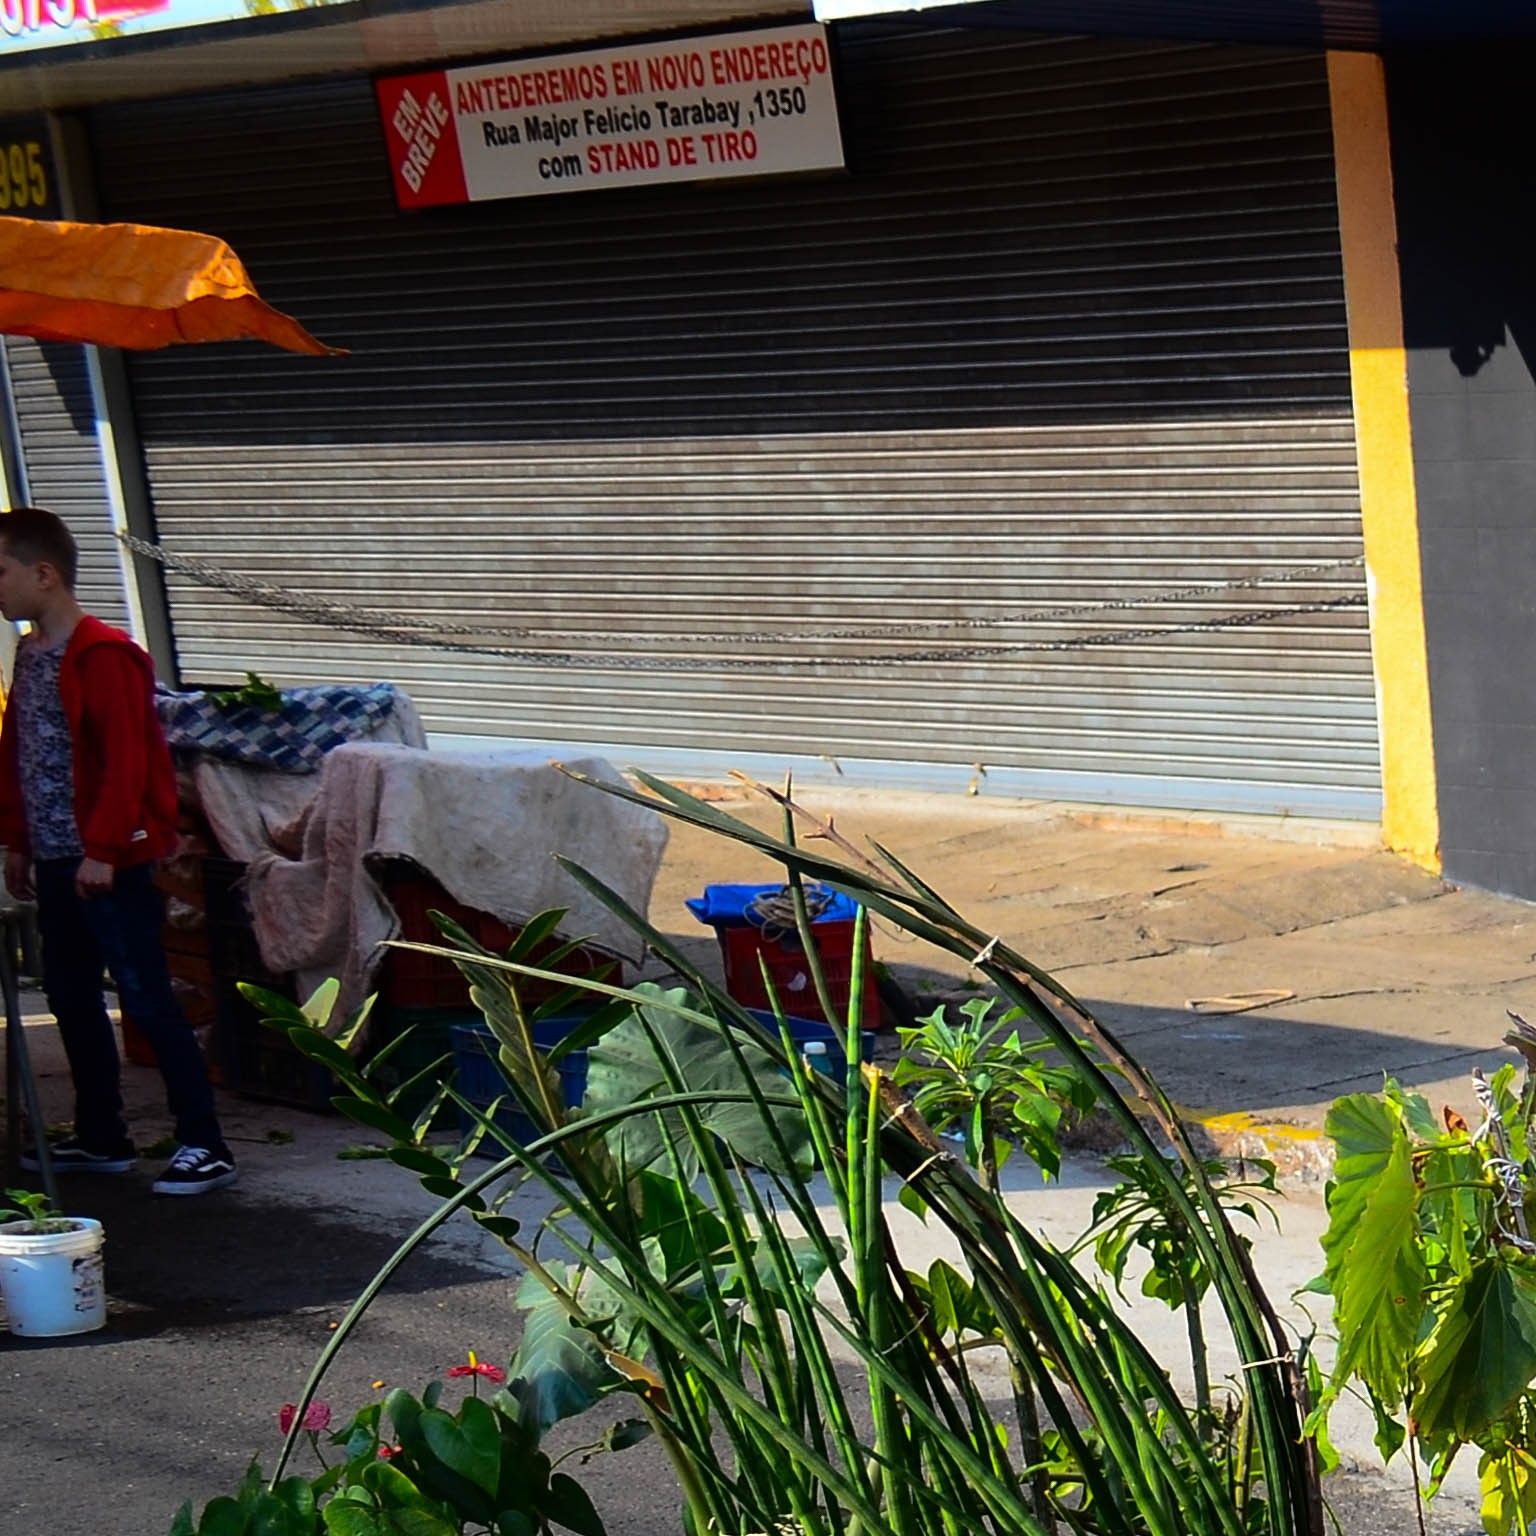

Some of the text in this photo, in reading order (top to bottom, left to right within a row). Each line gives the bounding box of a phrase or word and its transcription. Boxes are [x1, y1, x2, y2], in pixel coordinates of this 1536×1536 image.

[455, 38, 827, 115] ANTEDEREMOS EM NOVO ENDEREÇO
[392, 88, 422, 145] EM
[400, 91, 449, 195] BREVE
[483, 121, 521, 147] Rua
[524, 113, 579, 147] Major
[655, 97, 741, 129] Tarabay
[538, 130, 758, 179] com STAND DE TIRO
